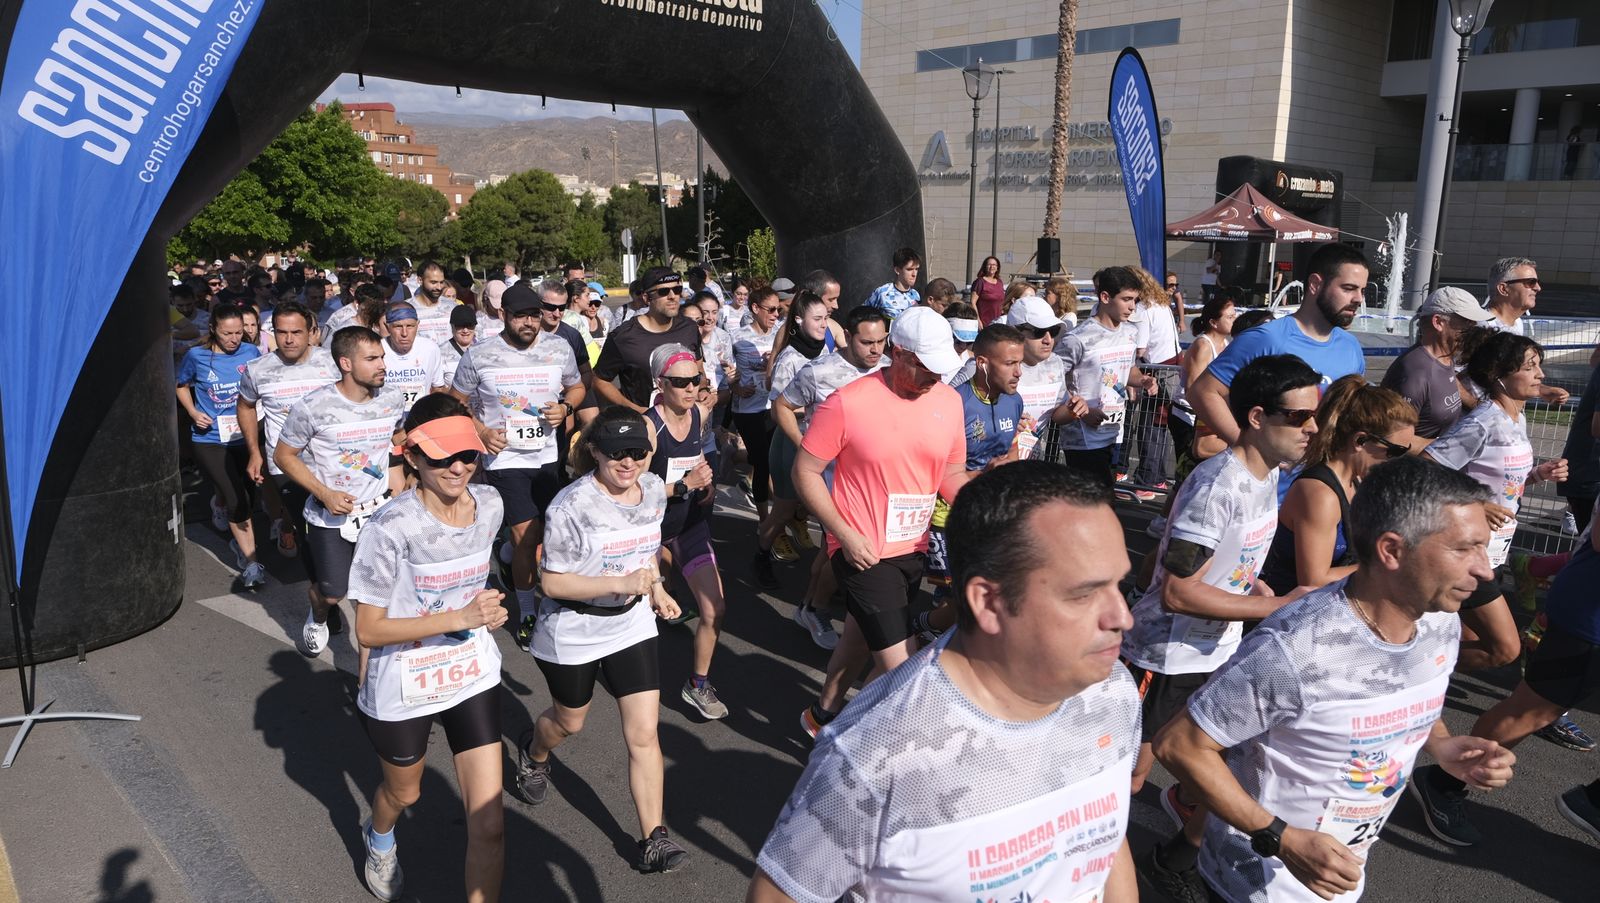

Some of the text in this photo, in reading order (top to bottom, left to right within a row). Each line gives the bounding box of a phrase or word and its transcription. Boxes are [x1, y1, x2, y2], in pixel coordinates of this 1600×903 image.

[702, 7, 763, 32] deportivo
[516, 426, 545, 439] 138
[414, 658, 481, 689] 1164
[968, 791, 1119, 868] II CARRERA SIN HUMO
